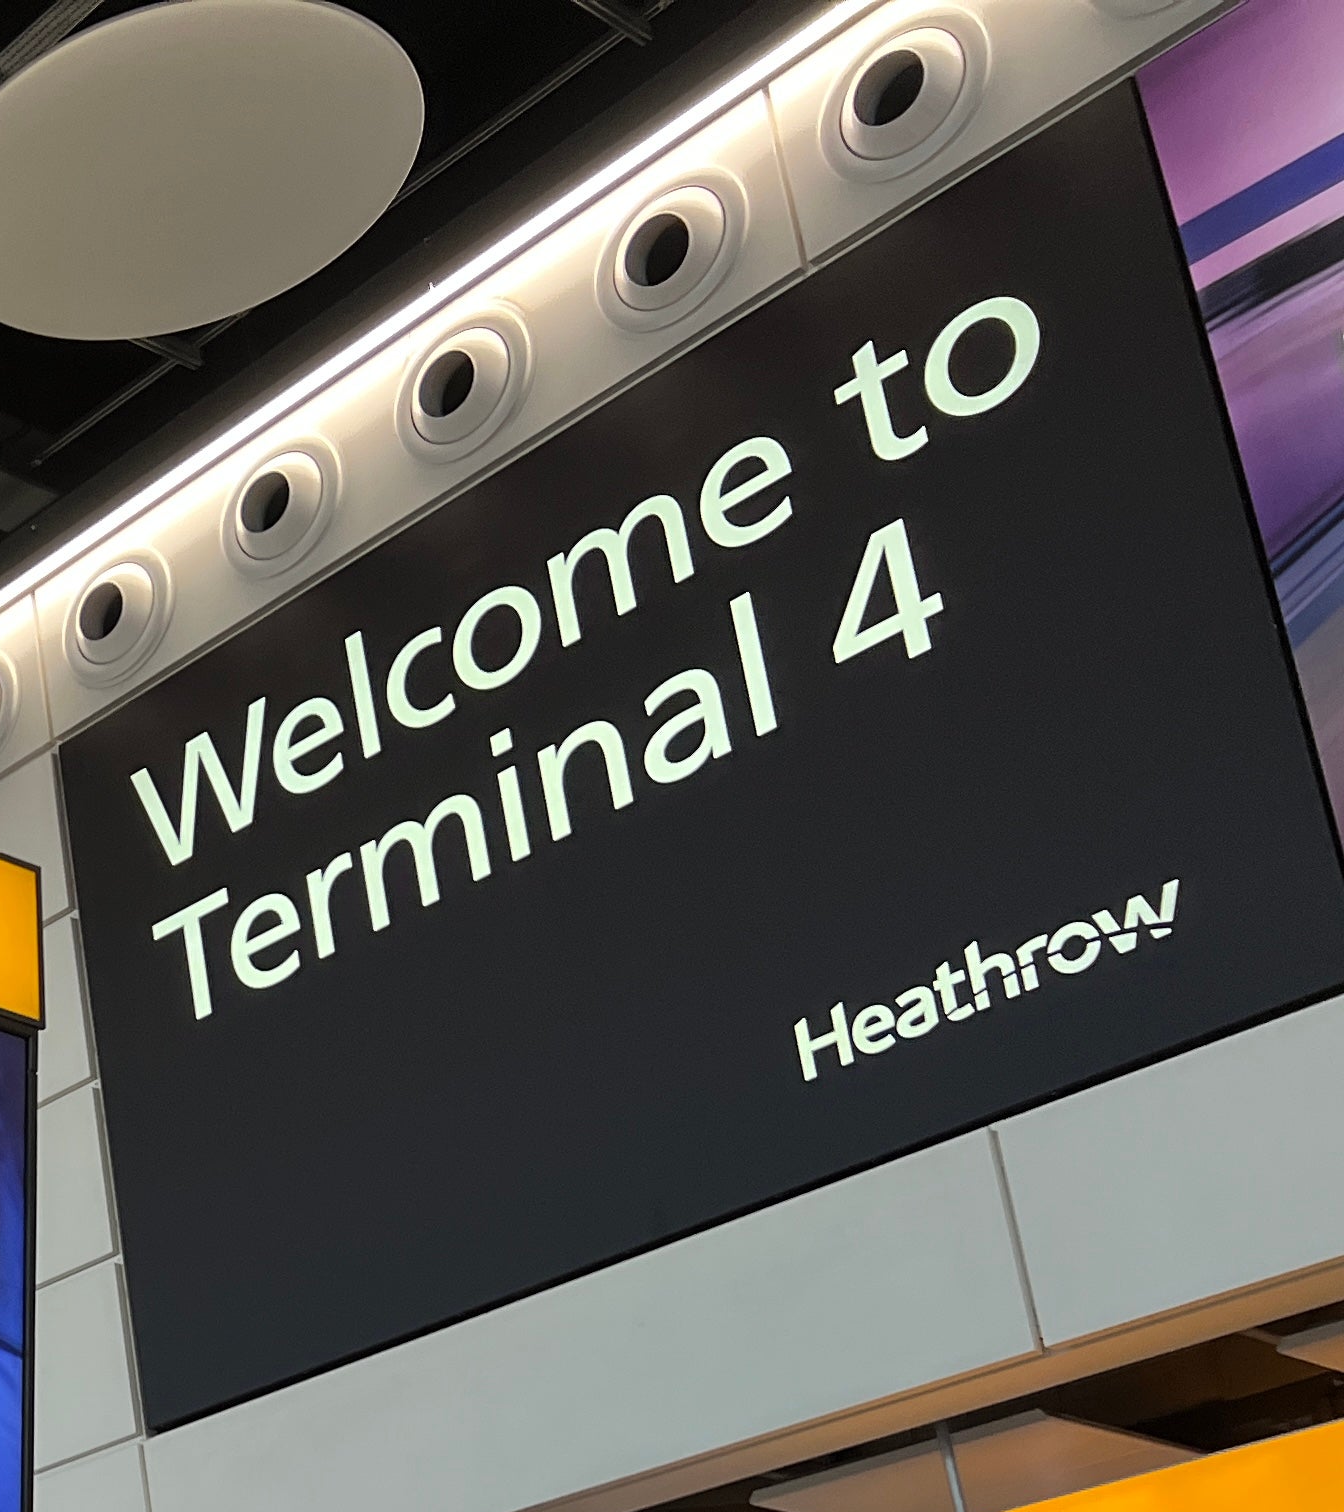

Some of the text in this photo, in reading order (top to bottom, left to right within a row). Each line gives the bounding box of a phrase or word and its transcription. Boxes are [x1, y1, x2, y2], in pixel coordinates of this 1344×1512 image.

[129, 295, 1042, 867] Welcome to
[151, 518, 945, 1023] Terminal 4
[791, 877, 1181, 1083] Heathrow
